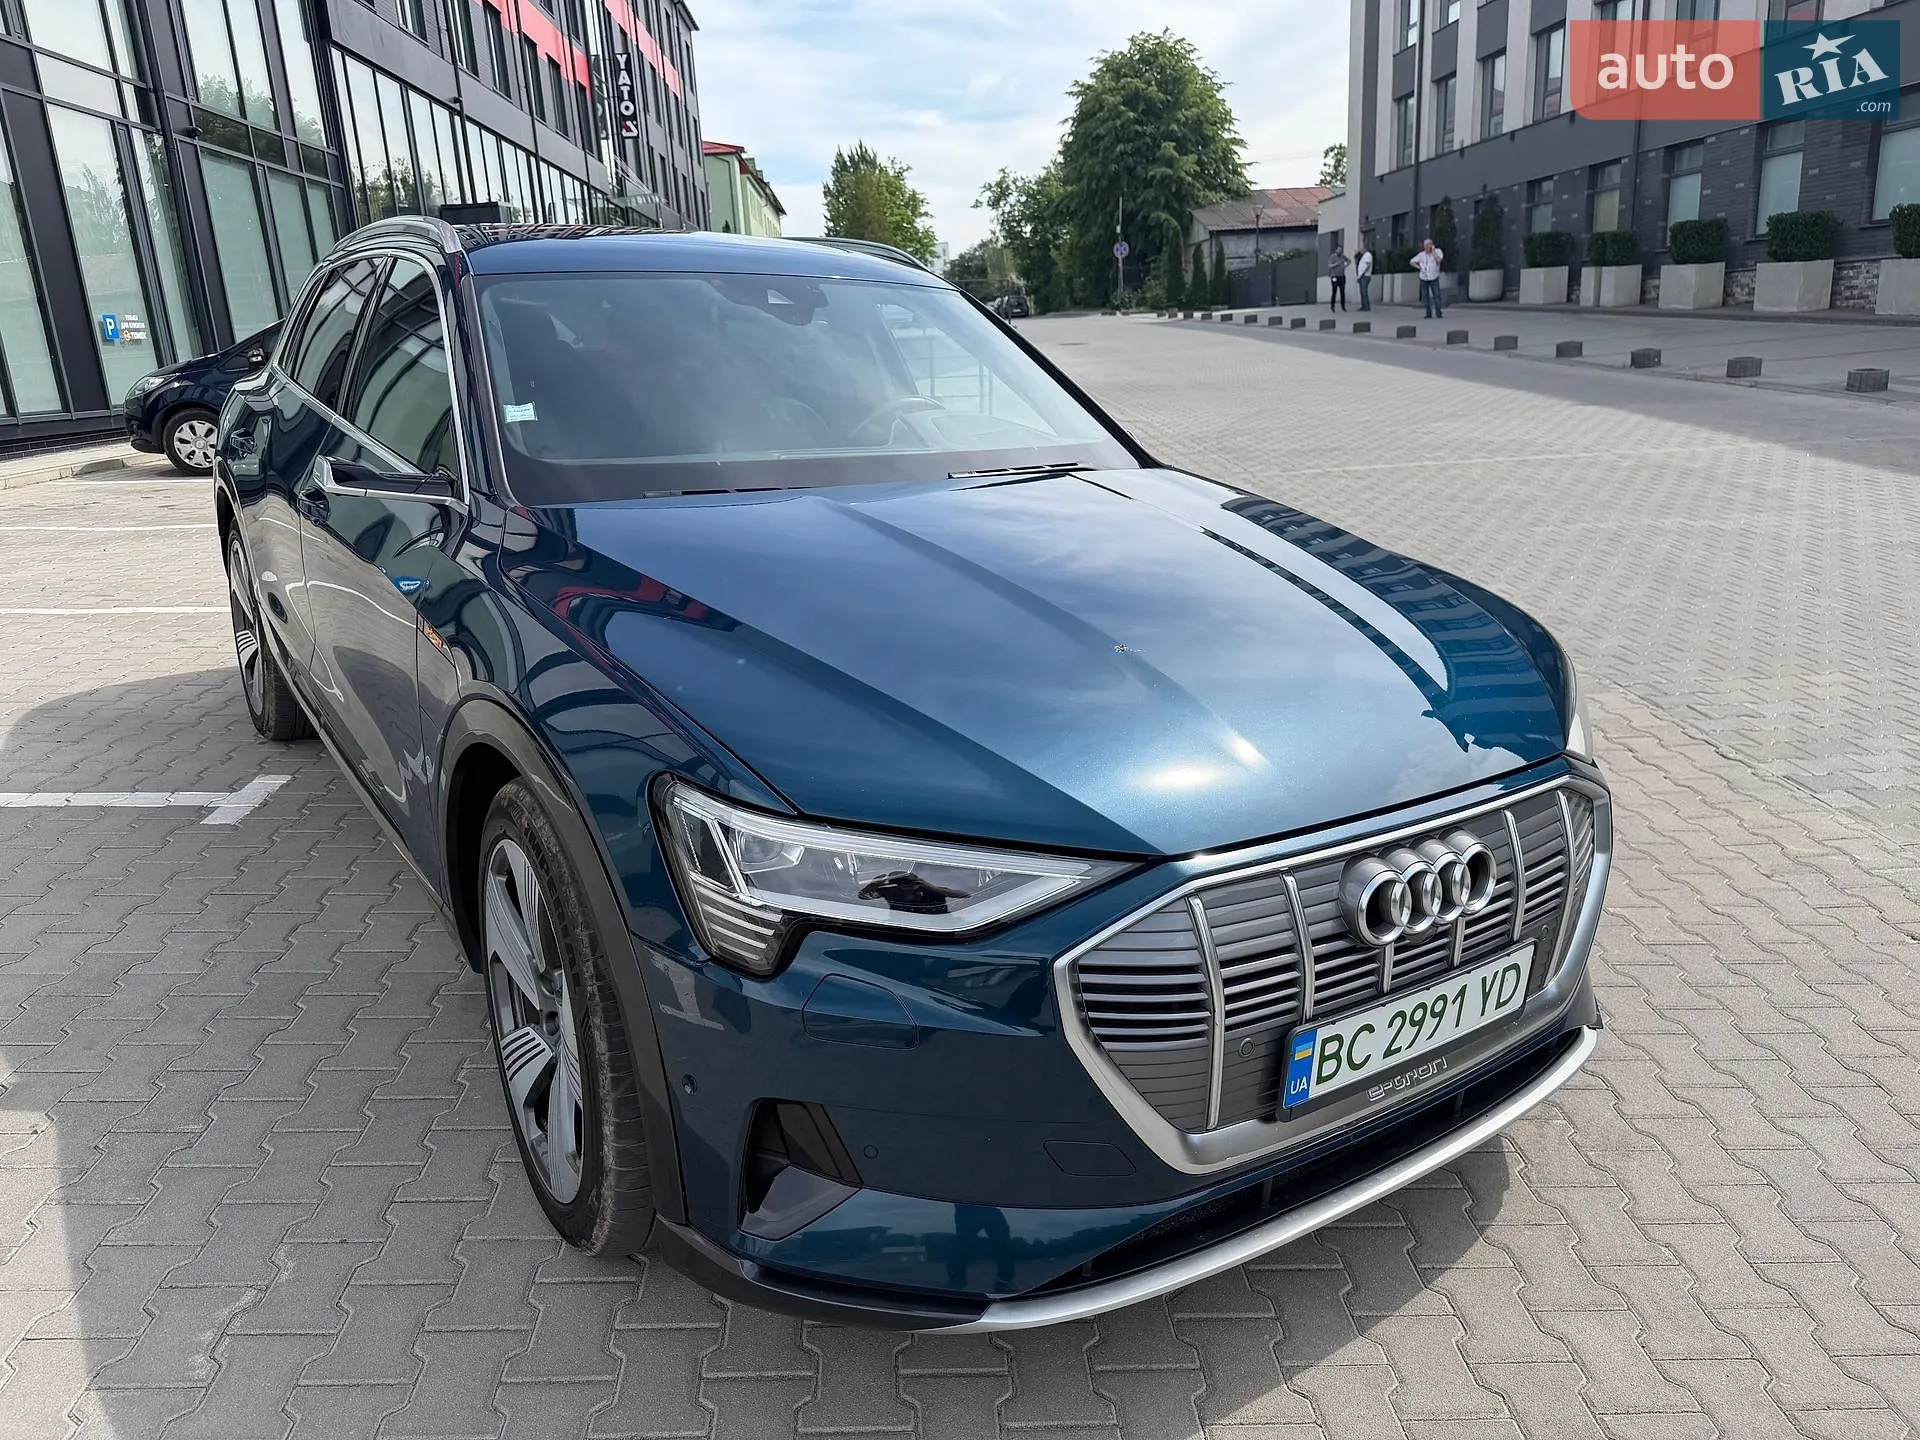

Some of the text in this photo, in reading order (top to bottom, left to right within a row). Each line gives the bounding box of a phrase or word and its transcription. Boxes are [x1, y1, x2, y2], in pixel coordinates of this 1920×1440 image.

[105, 318, 115, 336] P
[1315, 962, 1522, 1086] BC 2991 YD
[1290, 1080, 1308, 1095] UA
[1366, 1056, 1449, 1101] e-tron
